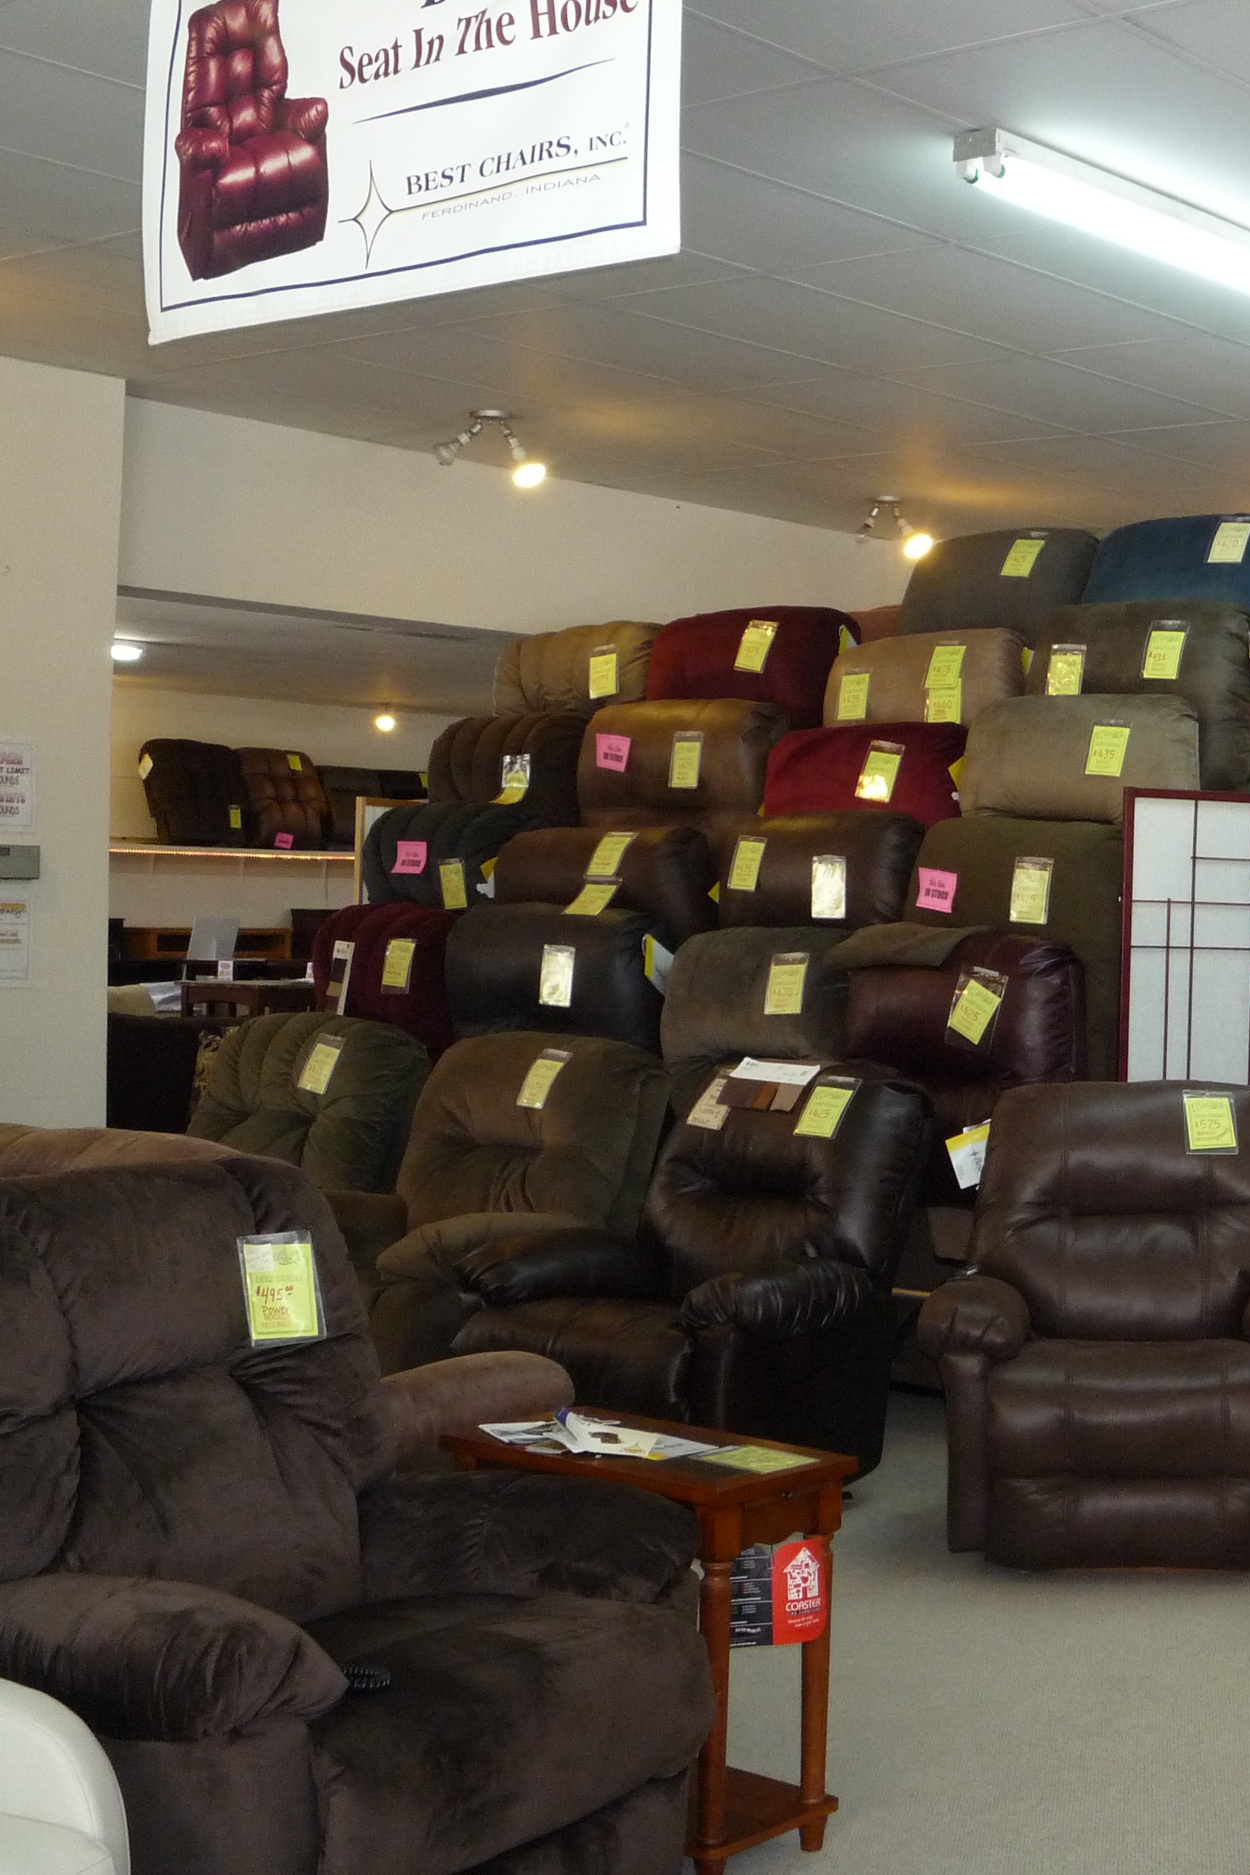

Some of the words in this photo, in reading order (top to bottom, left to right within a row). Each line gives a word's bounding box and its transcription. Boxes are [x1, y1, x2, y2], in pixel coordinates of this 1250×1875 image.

[339, 37, 403, 89] Seat
[410, 27, 445, 71] In
[455, 8, 516, 56] The
[406, 163, 472, 195] BEST
[479, 136, 578, 178] CHAIRS,
[588, 131, 627, 151] INC.
[525, 174, 602, 194] INDIANA
[0, 806, 19, 816] OUNDS
[1195, 1119, 1221, 1129] $575
[785, 1598, 821, 1612] COASTER
